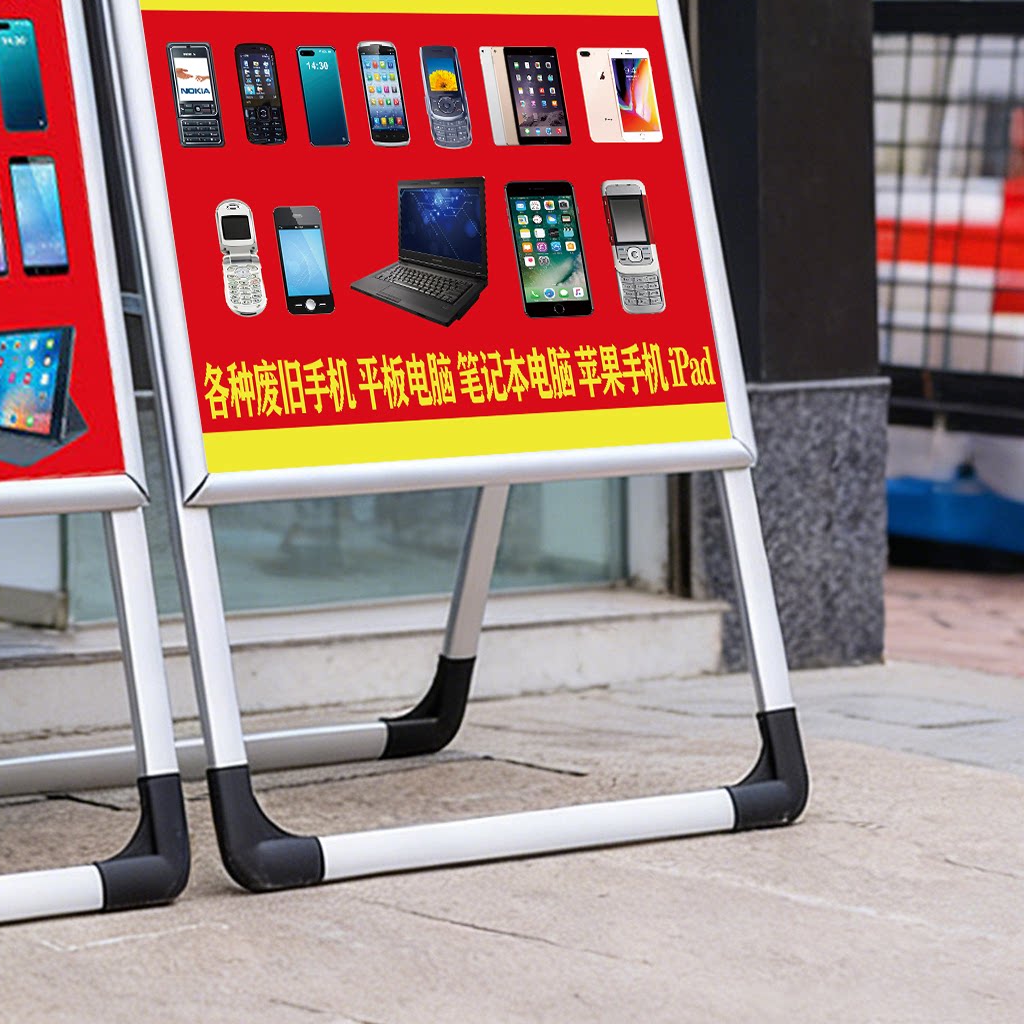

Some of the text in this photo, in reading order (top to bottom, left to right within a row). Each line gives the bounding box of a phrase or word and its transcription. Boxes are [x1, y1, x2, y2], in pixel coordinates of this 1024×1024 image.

[306, 61, 329, 71] 14:30
[180, 87, 211, 95] NOKIA
[204, 342, 717, 419] 各种废旧手机 平板电脑 笔记本电脑 苹果手机 iPad
